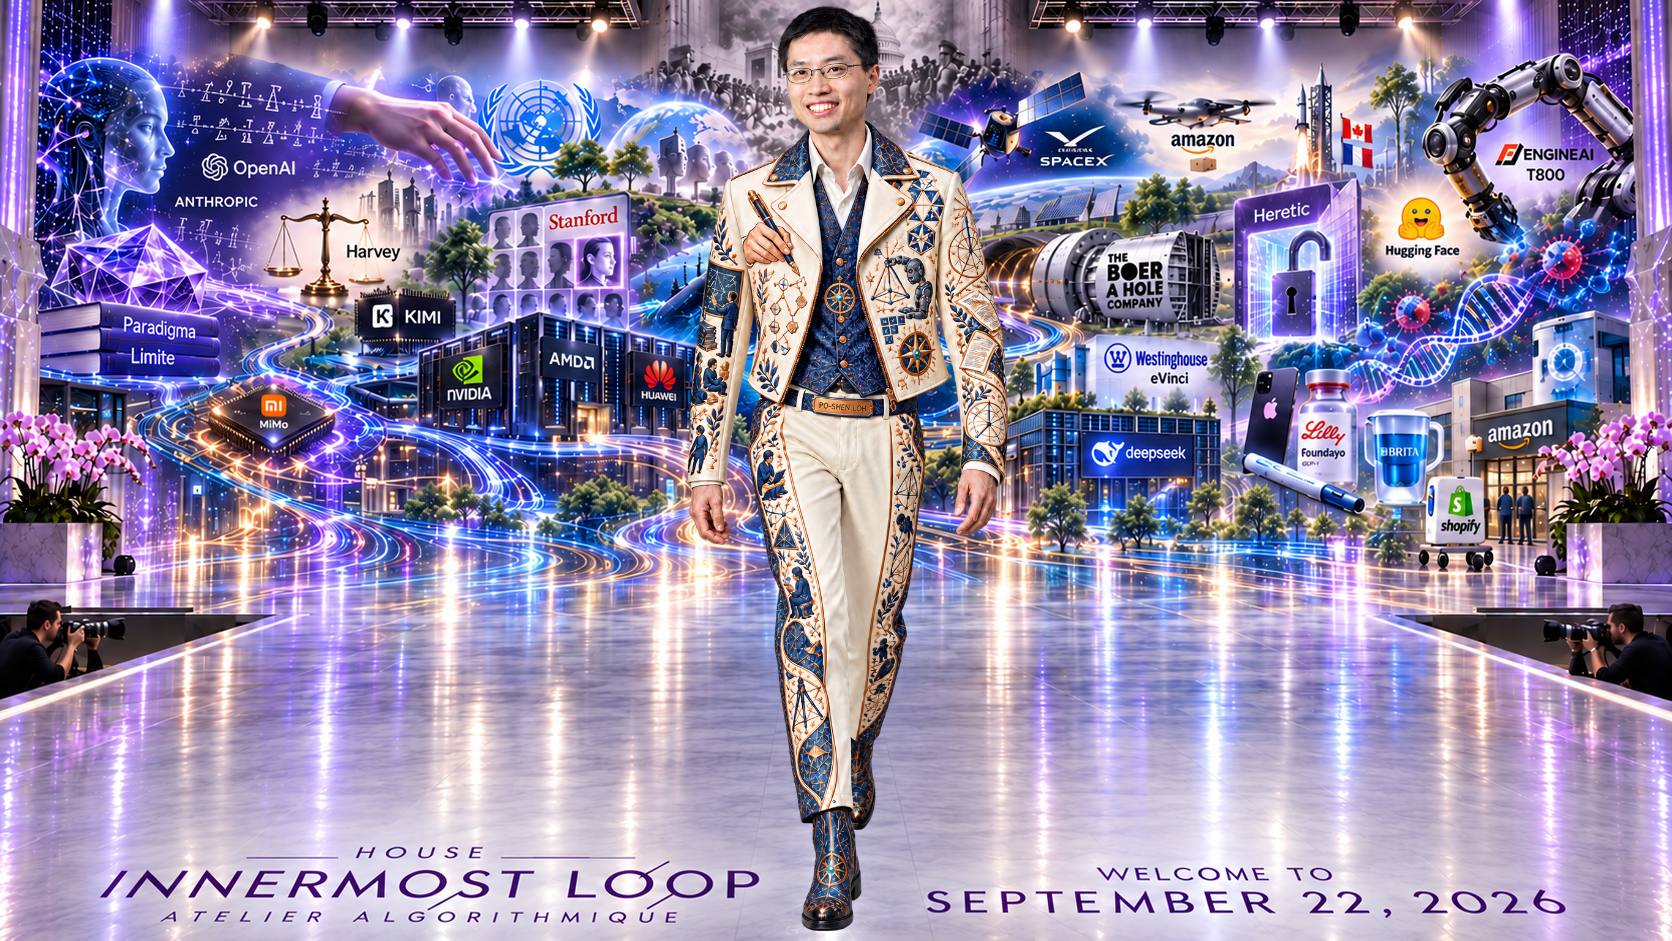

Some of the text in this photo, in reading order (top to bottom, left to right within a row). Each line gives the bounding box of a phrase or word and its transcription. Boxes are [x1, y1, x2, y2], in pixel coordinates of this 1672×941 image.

[1171, 133, 1235, 147] amazon
[1040, 154, 1115, 167] SPACEX
[1523, 148, 1594, 162] ENGINEAI
[234, 160, 296, 179] OpenAI
[1527, 168, 1566, 182] T800
[175, 196, 259, 208] ANTHROPIC
[549, 205, 619, 231] Stanford
[1253, 202, 1311, 224] Heretic
[346, 244, 400, 262] Harvey
[1108, 252, 1128, 263] THE
[1385, 244, 1460, 259] Hugging Face
[1106, 281, 1163, 298] A HOLE
[1107, 297, 1163, 309] COMPANY
[404, 309, 441, 325] KIMI
[123, 316, 196, 340] Paradigma
[131, 347, 175, 366] Limite
[549, 352, 585, 368] AMD
[1135, 350, 1208, 370] Westinghouse
[1150, 372, 1189, 385] eVinci
[641, 391, 677, 402] HUAWEI
[818, 402, 850, 411] PO-SHEN
[259, 420, 289, 429] MiMo
[1488, 419, 1553, 443] amazon
[1301, 420, 1346, 446] Lilly
[1125, 445, 1187, 461] deepseek
[1301, 448, 1346, 459] Foundayo
[1389, 447, 1419, 457] BRITA
[1440, 519, 1481, 535] shopify
